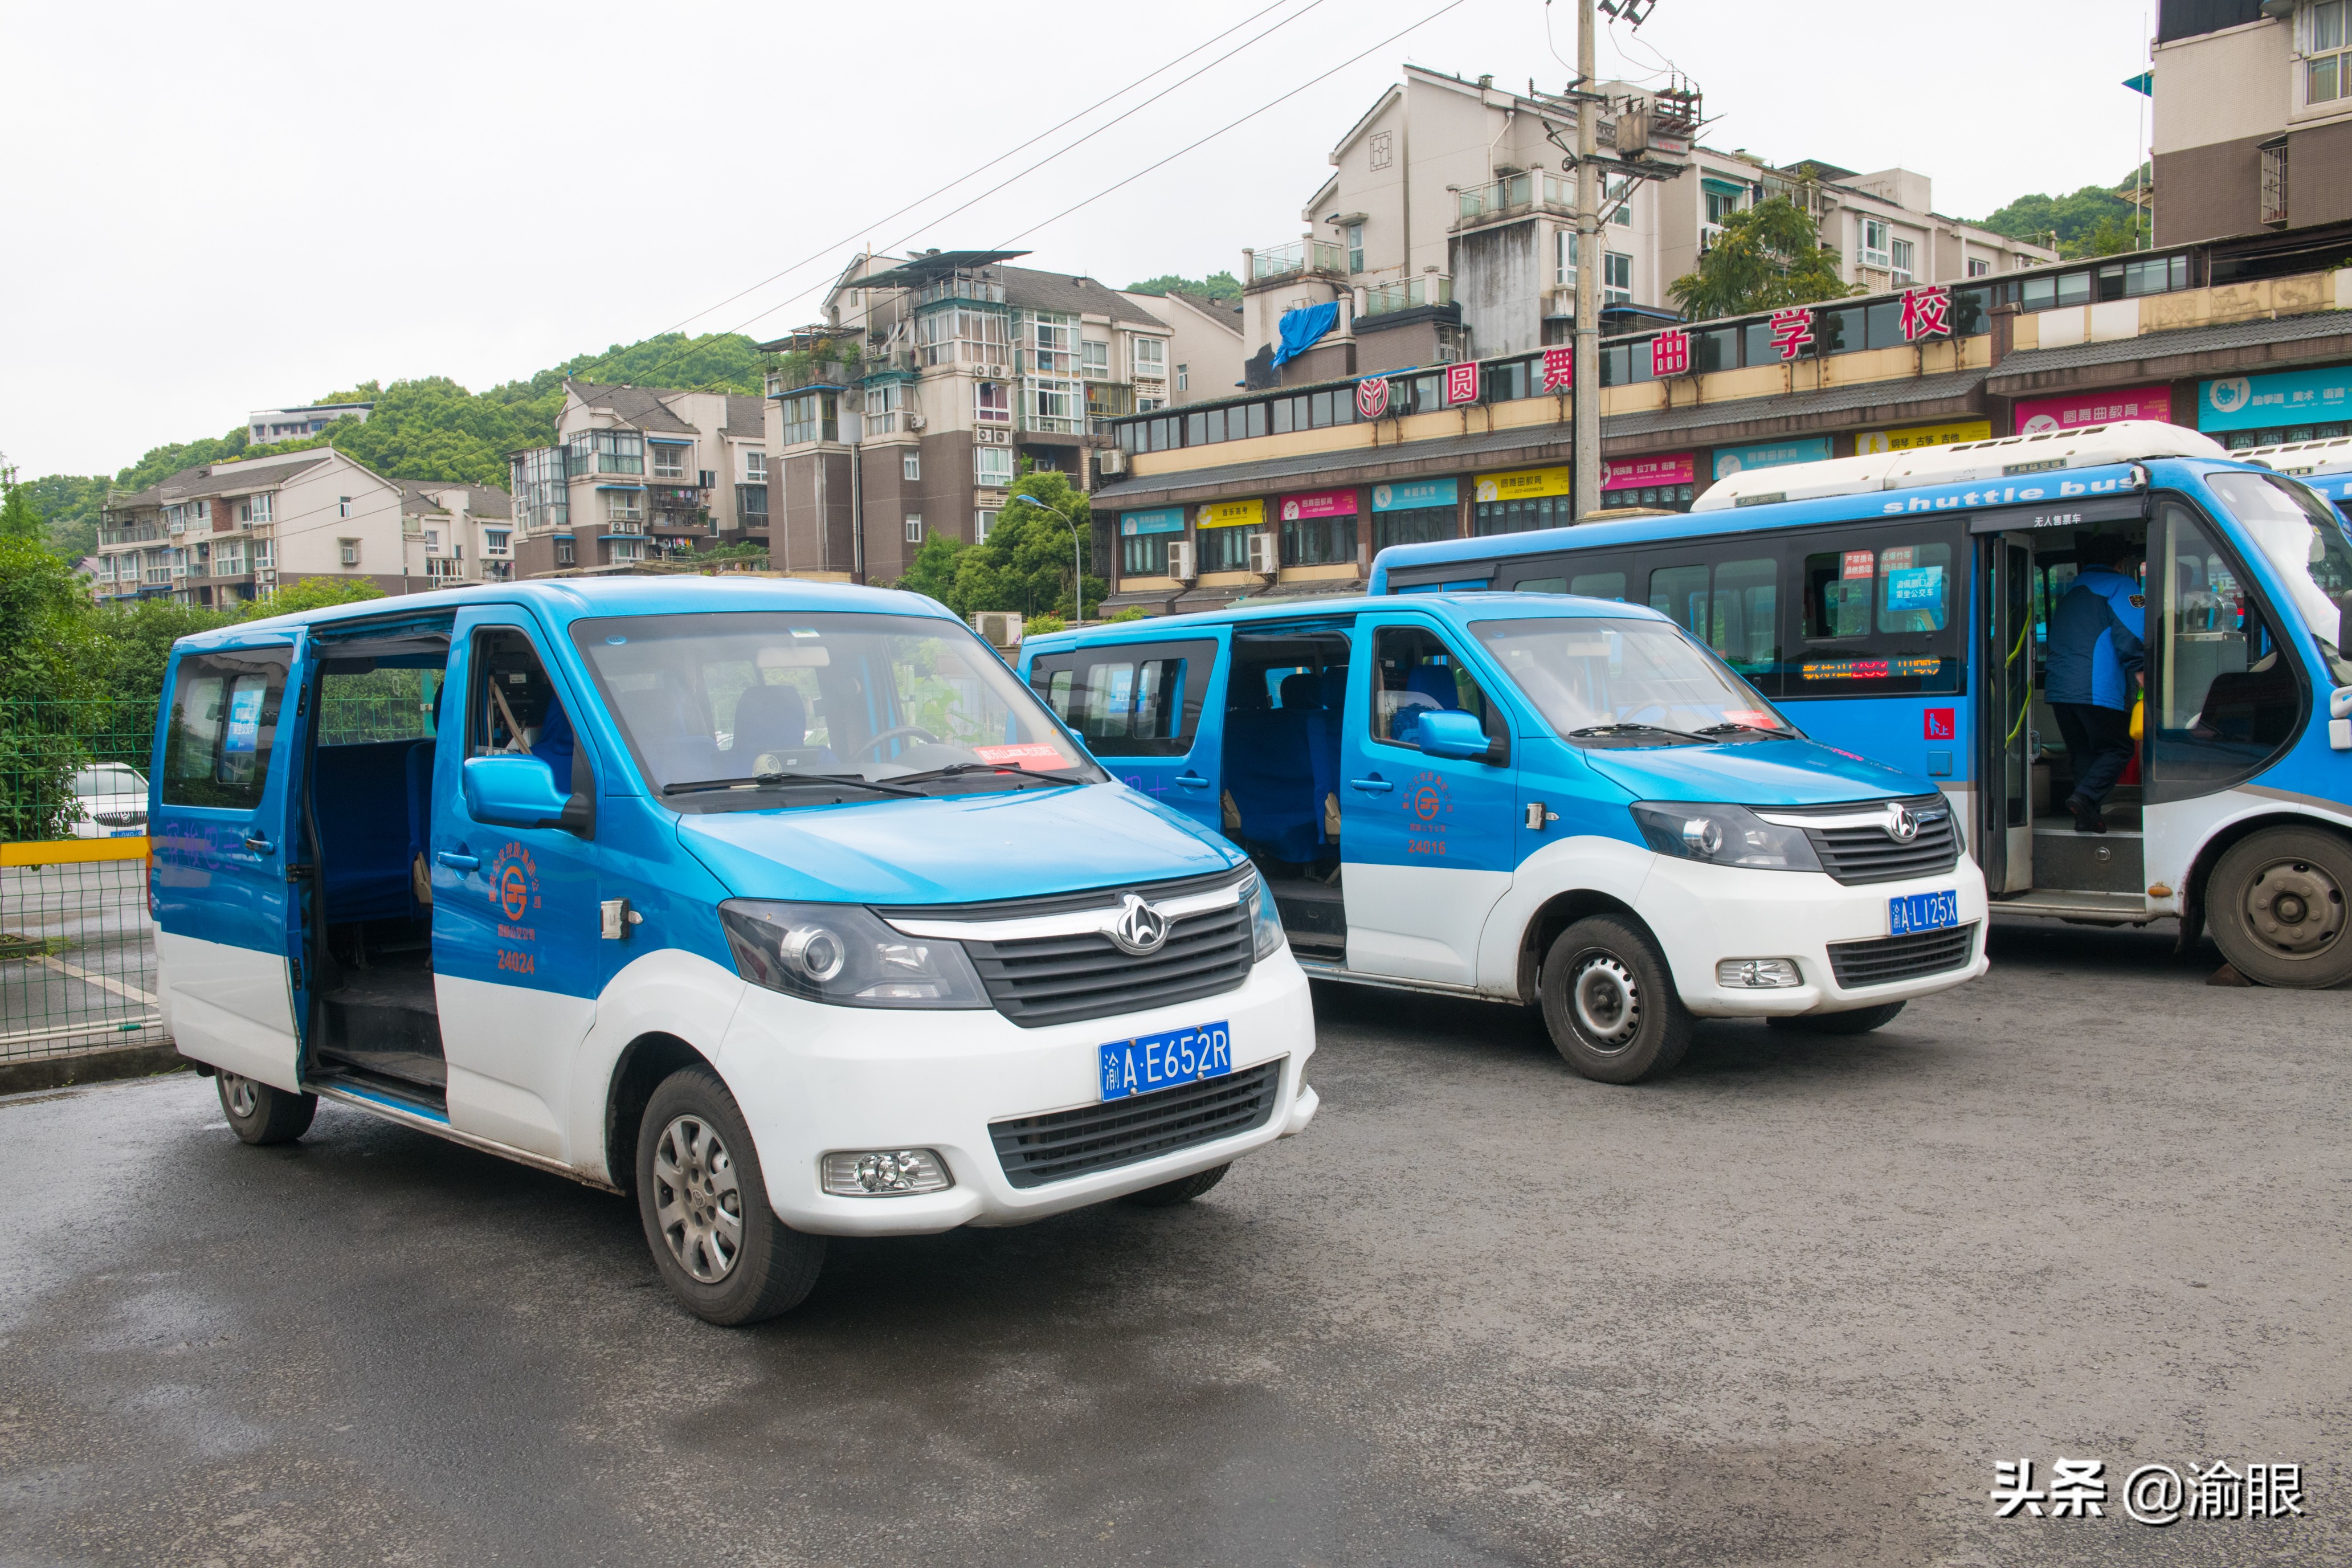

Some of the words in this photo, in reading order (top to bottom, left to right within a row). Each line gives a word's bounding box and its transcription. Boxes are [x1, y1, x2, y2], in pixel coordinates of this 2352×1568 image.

[2293, 390, 2314, 402] 美术
[2323, 387, 2345, 399] 语言
[2063, 403, 2138, 424] 圆舞曲教育
[1891, 438, 1909, 448] 钢琴
[1916, 435, 1934, 446] 古筝
[1941, 432, 1959, 444] 吉他
[1613, 466, 1632, 476] 民族舞
[1636, 463, 1657, 473] 拉丁舞
[1661, 462, 1676, 471] 街舞
[1501, 475, 1542, 488] 圆舞曲教育
[1883, 487, 2045, 515] shuttle
[2060, 475, 2134, 497] bus
[1222, 507, 1248, 516] 音乐高考
[2034, 513, 2081, 528] 无人售票车
[1896, 588, 1934, 599] 乘坐公交车
[1408, 839, 1446, 855] 24016
[497, 949, 535, 975] 24024
